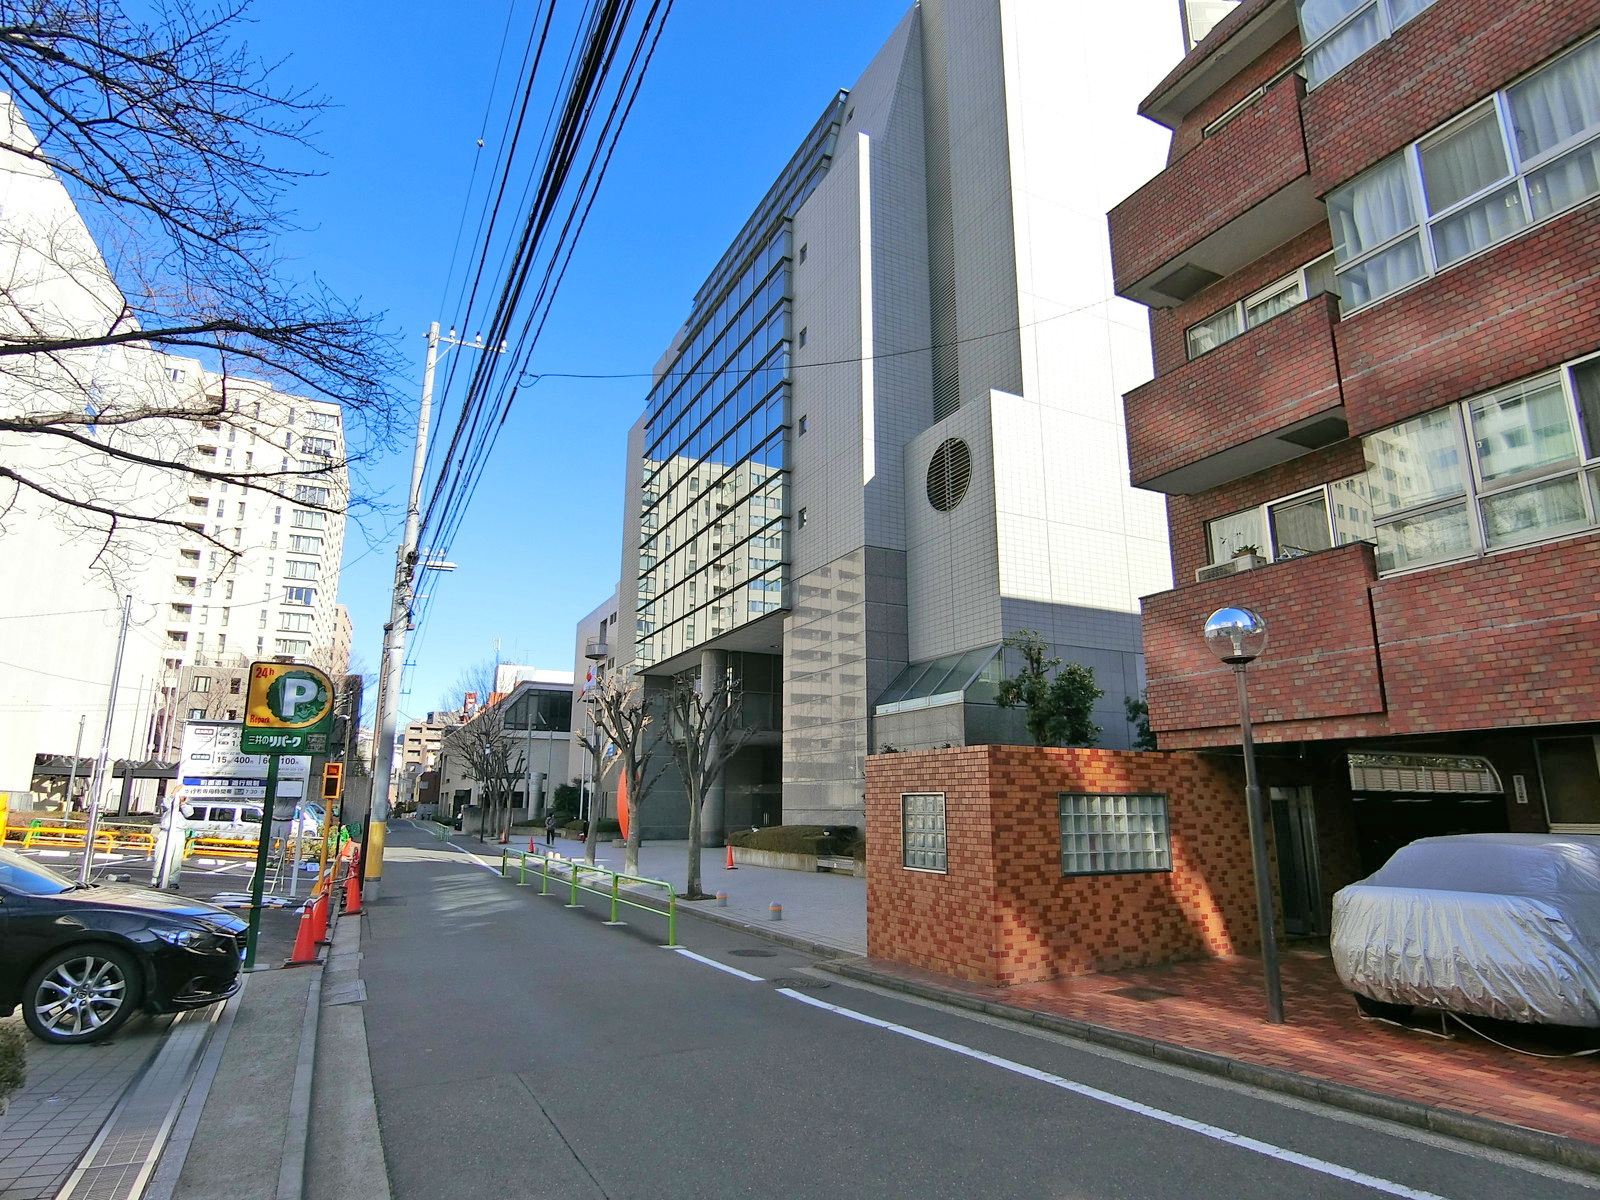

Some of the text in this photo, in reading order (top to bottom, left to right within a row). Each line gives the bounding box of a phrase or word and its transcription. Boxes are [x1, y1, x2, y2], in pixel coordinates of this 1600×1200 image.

[255, 667, 275, 679] 24h
[282, 678, 318, 717] P
[249, 714, 270, 725] Repark
[248, 735, 302, 748] 三井のリパーク
